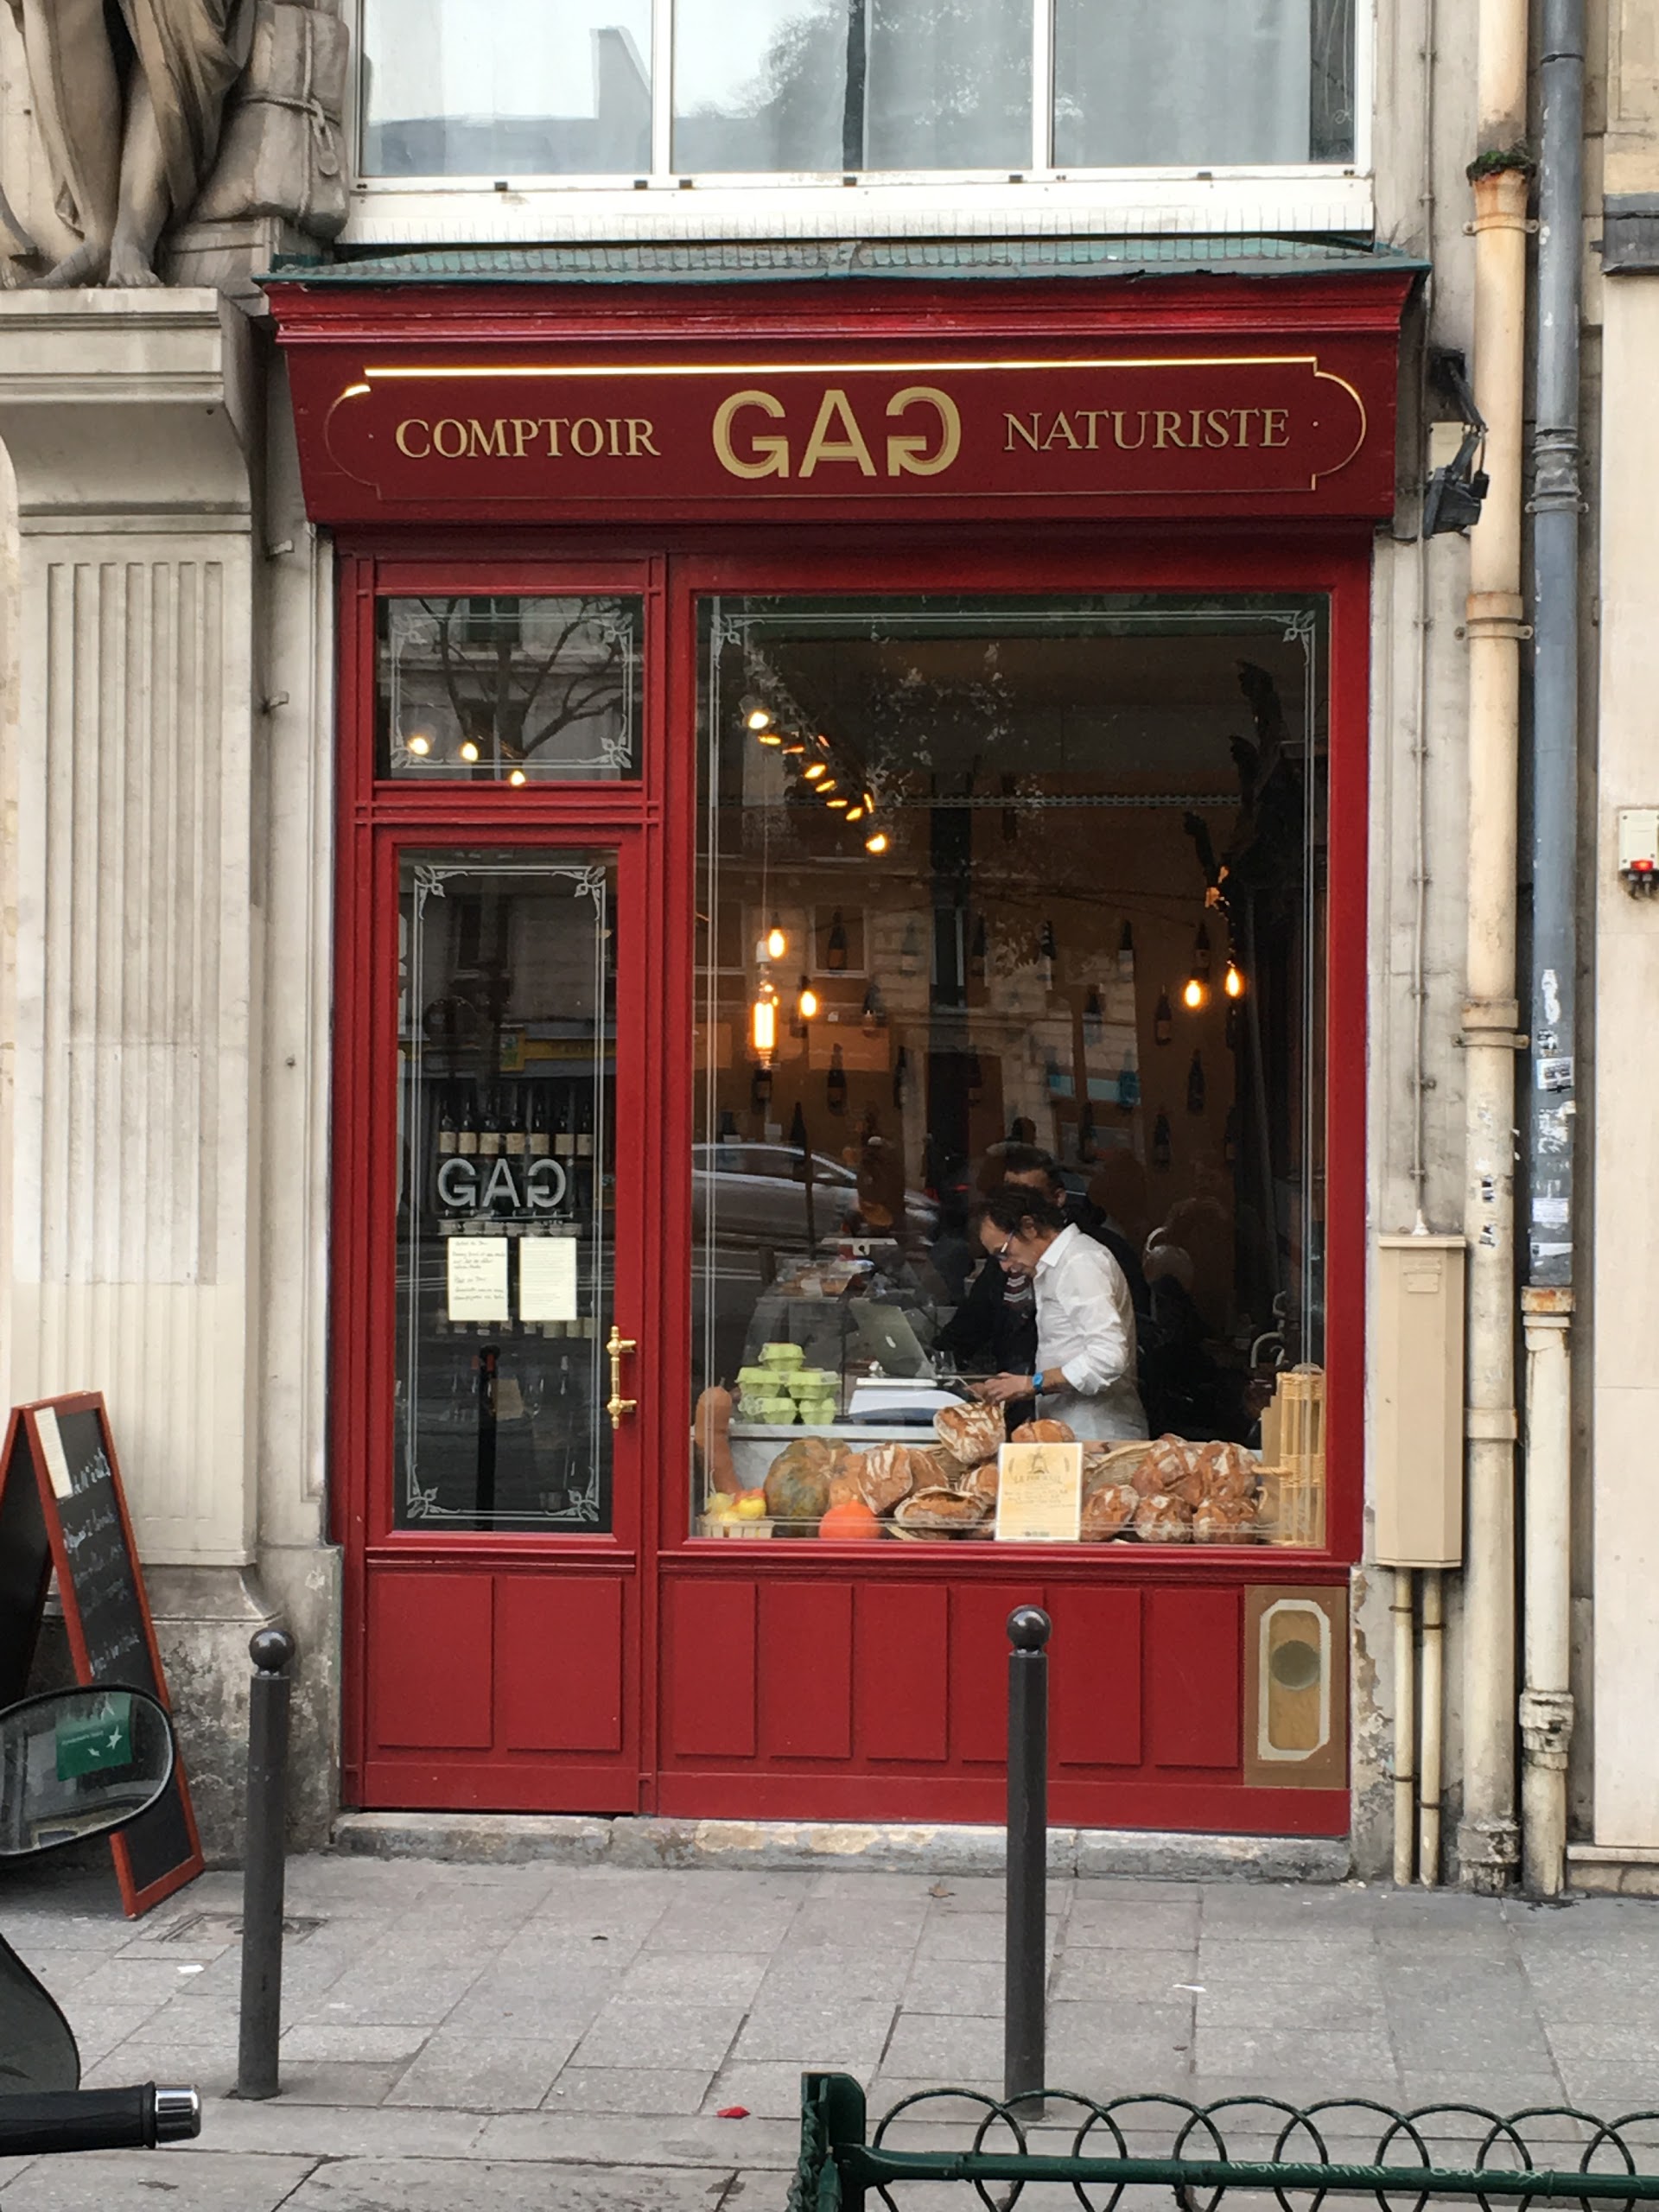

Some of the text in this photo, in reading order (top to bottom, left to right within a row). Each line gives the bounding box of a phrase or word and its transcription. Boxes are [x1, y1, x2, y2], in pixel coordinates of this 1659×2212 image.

[396, 386, 1290, 479] COMPTOIR GAG NATURISTE
[438, 1158, 566, 1208] GAG
